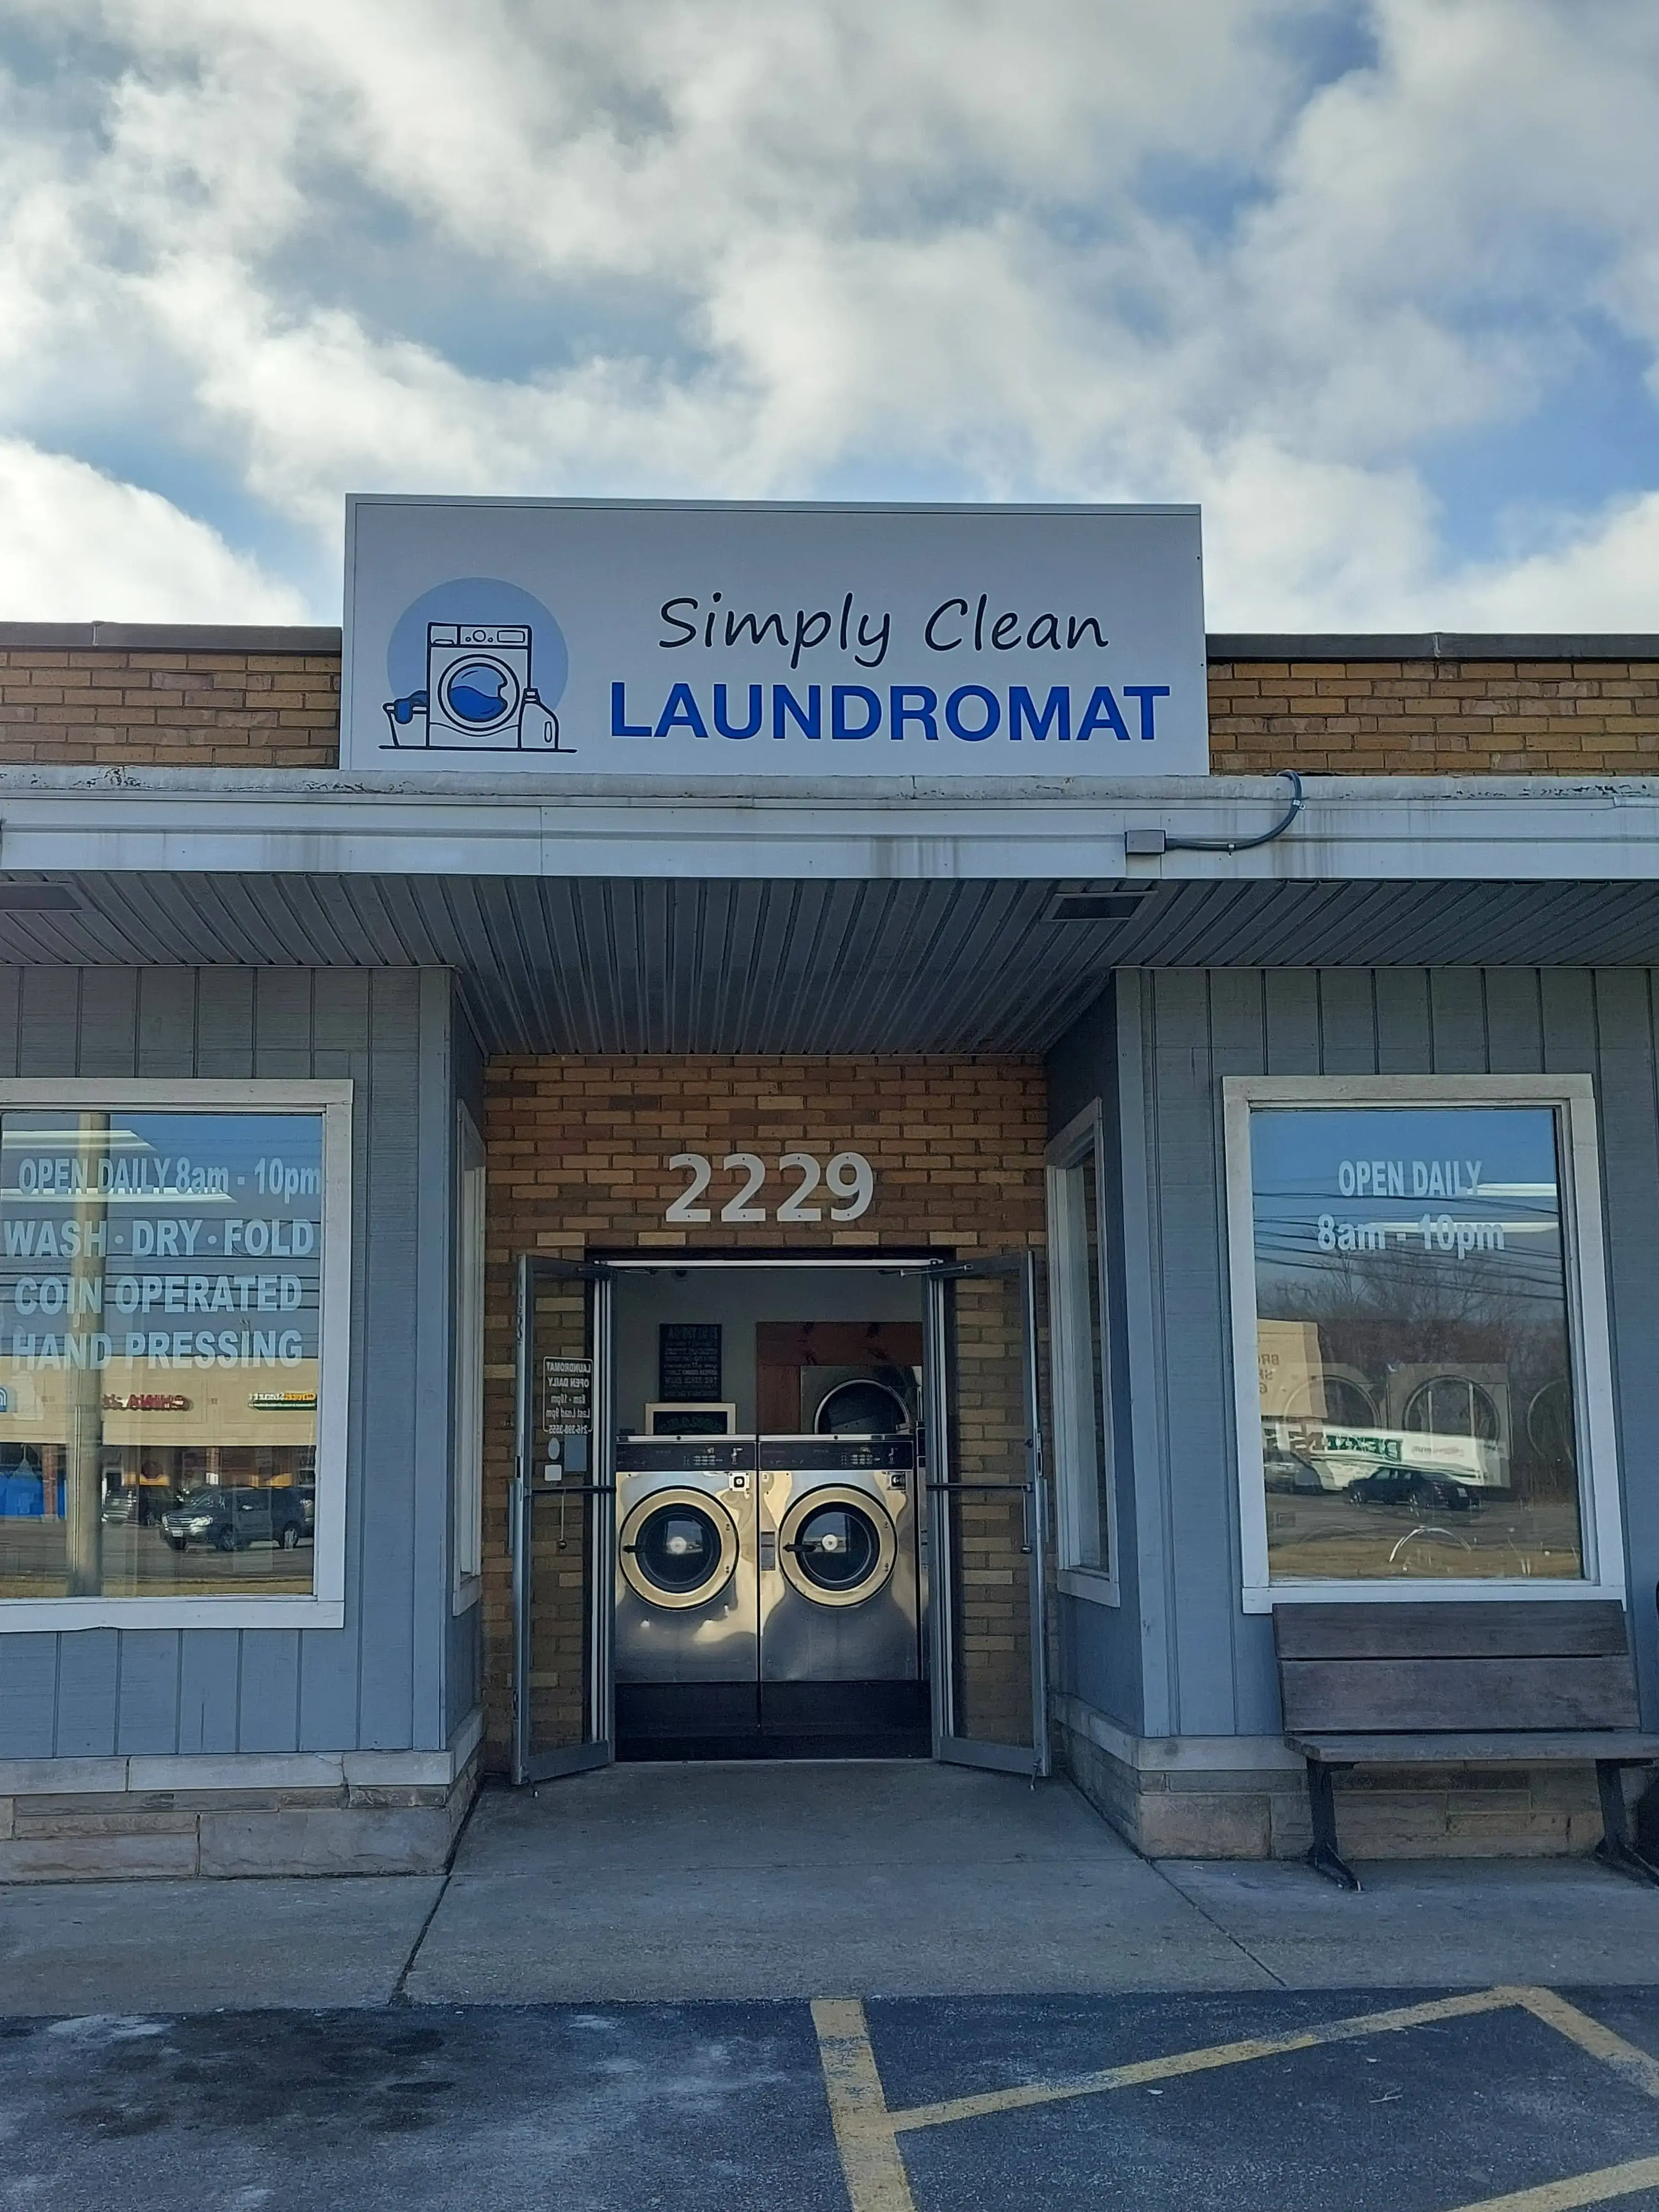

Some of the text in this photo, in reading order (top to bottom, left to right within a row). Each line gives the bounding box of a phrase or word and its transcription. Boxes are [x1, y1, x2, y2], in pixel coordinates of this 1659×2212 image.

[658, 591, 1109, 669] Simply Clean
[610, 681, 1171, 741] LAUNDROMAT
[19, 1158, 88, 1194] OPEN
[98, 1158, 171, 1194] DAILY
[176, 1157, 229, 1194] 8am
[255, 1158, 320, 1203] 10pm
[665, 1152, 874, 1222] 2229
[1338, 1160, 1482, 1196] OPEN DAILY
[2, 1220, 108, 1257] WASH
[132, 1219, 203, 1256] DRY
[224, 1218, 314, 1255] FOLD
[1317, 1214, 1385, 1250] 8am
[1418, 1214, 1504, 1260] 10pm
[14, 1274, 302, 1315] COIN OPERATED
[12, 1330, 303, 1370] HAND PRESSING
